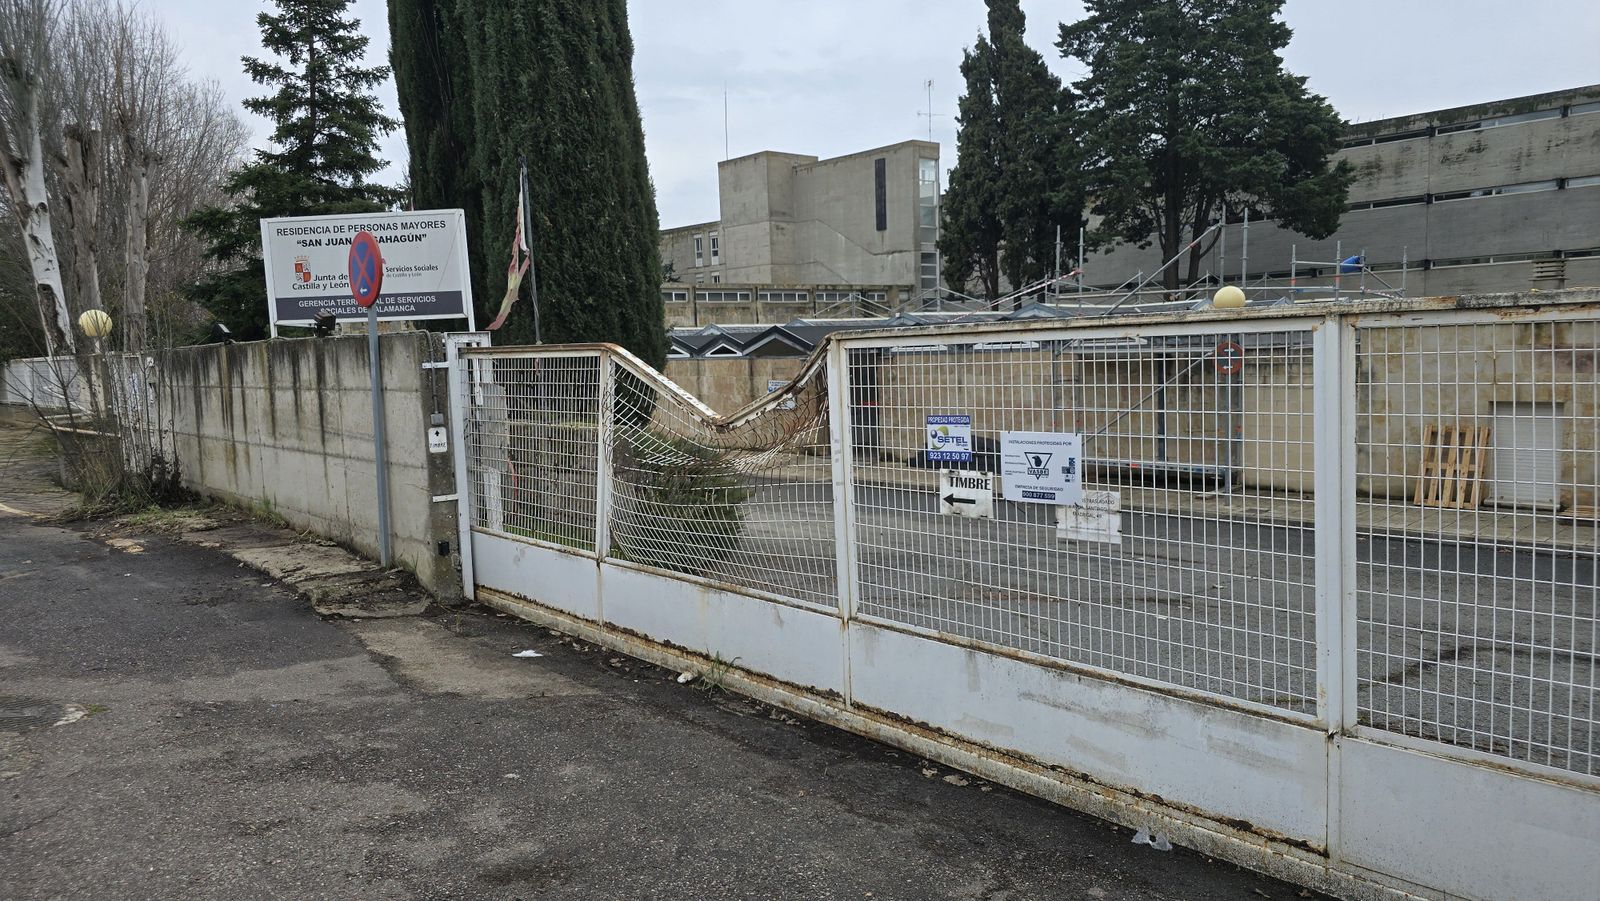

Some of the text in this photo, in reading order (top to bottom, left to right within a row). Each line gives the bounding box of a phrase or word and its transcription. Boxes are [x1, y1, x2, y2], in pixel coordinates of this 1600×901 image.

[276, 220, 446, 236] RESIDENCIA DE PERSONAS MAYORES
[325, 237, 352, 246] JUAN
[292, 282, 320, 290] Castilla
[298, 299, 335, 308] GERENCIA
[397, 295, 436, 303] SERVICIOS
[376, 304, 415, 313] ALAMANCA
[937, 435, 968, 444] SETEL
[949, 476, 991, 491] TIMBRE
